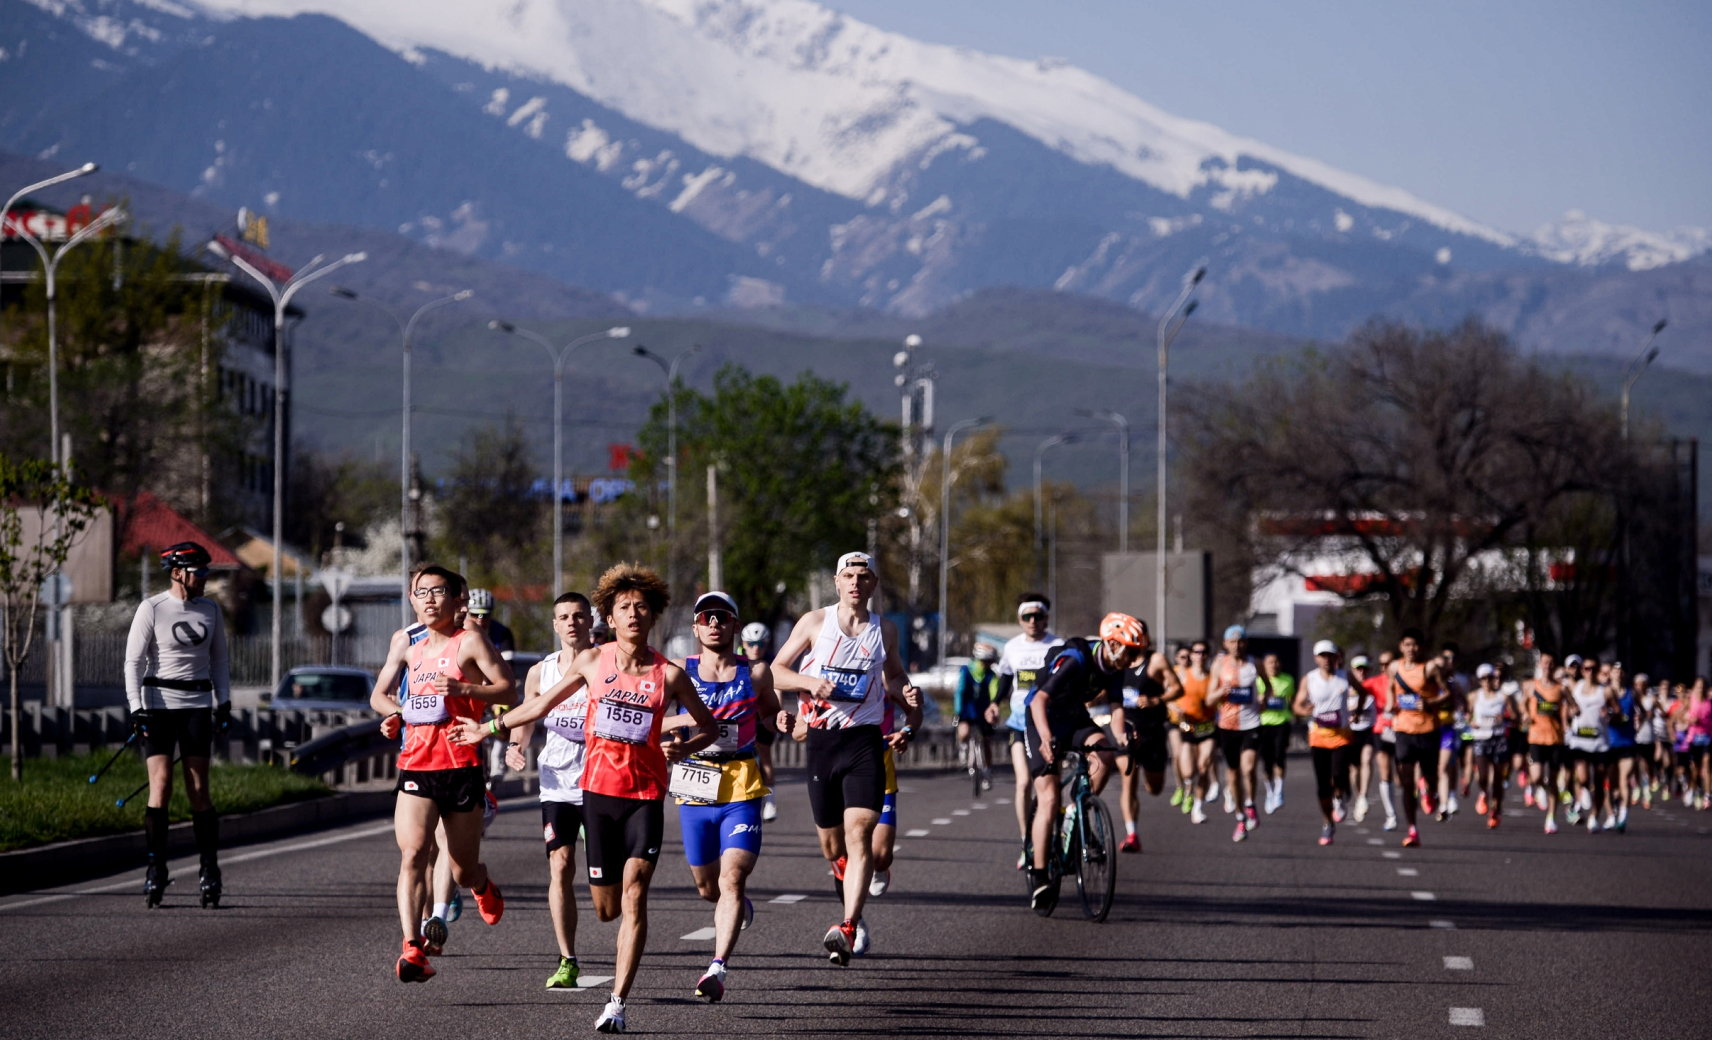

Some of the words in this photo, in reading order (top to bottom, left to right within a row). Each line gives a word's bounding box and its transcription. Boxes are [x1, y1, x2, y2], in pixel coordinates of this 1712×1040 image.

[410, 696, 437, 711] 1559
[604, 688, 650, 705] JAPAN
[554, 717, 586, 730] 1557
[606, 706, 644, 726] 1558
[681, 768, 711, 785] 7715
